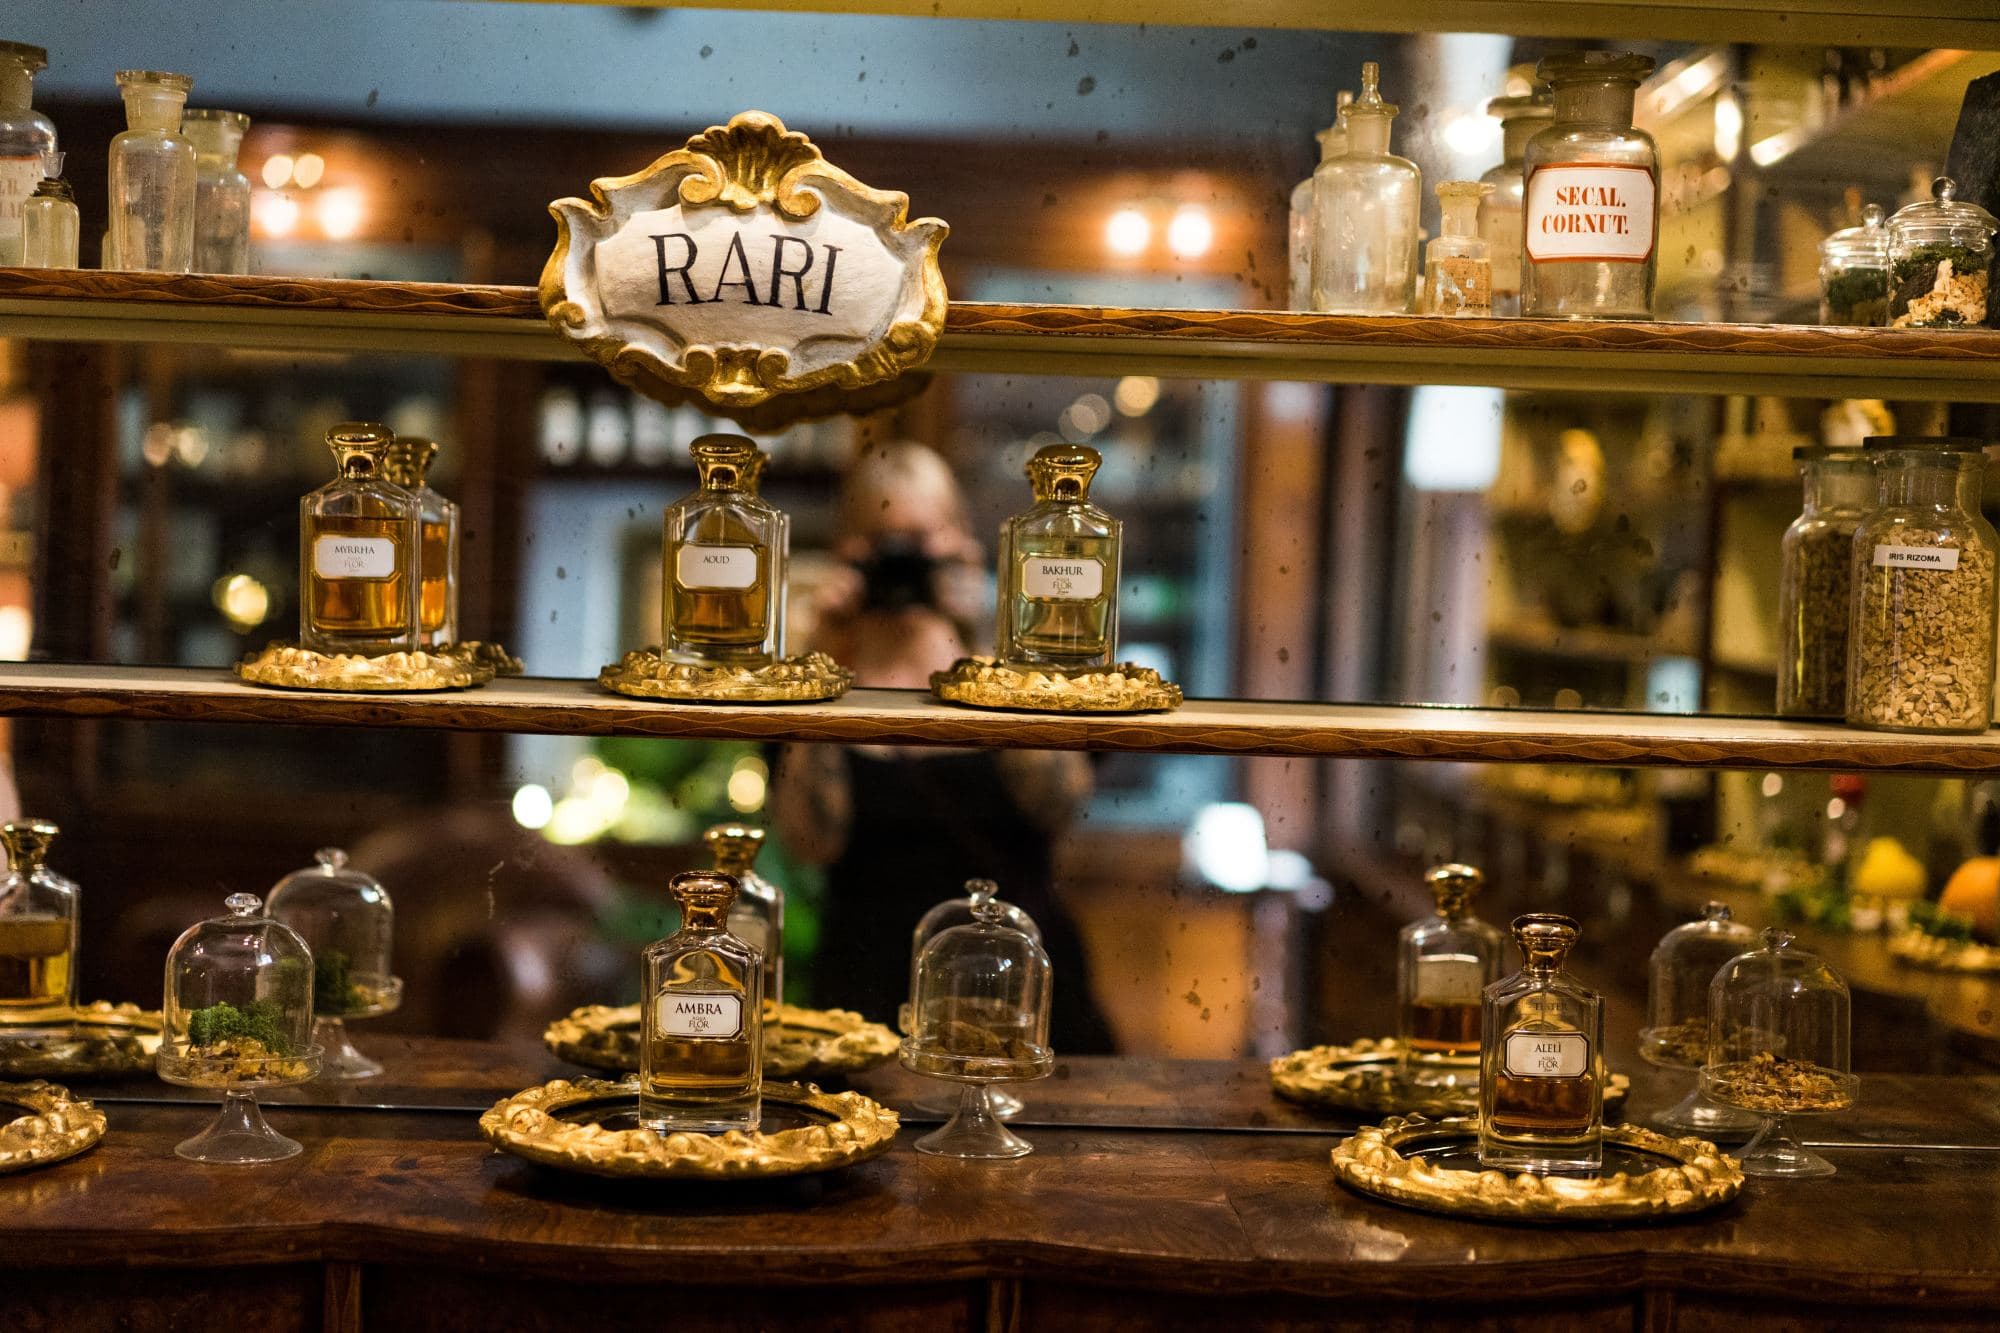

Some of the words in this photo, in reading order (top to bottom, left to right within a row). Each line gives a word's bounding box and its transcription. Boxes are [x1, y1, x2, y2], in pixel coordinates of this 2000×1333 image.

[1556, 186, 1627, 208] SECAL.
[1541, 213, 1629, 235] CORNUT.
[648, 231, 844, 315] RARI
[334, 545, 376, 555] MYRRHA
[703, 555, 731, 565] AOUD
[1889, 552, 1905, 561] IRIS
[1906, 554, 1942, 563] RIZOMA
[1042, 565, 1084, 576] BAKHUR
[675, 1002, 723, 1015] AMBRA
[688, 1020, 710, 1029] FLOR
[1538, 1060, 1559, 1069] FLOR
